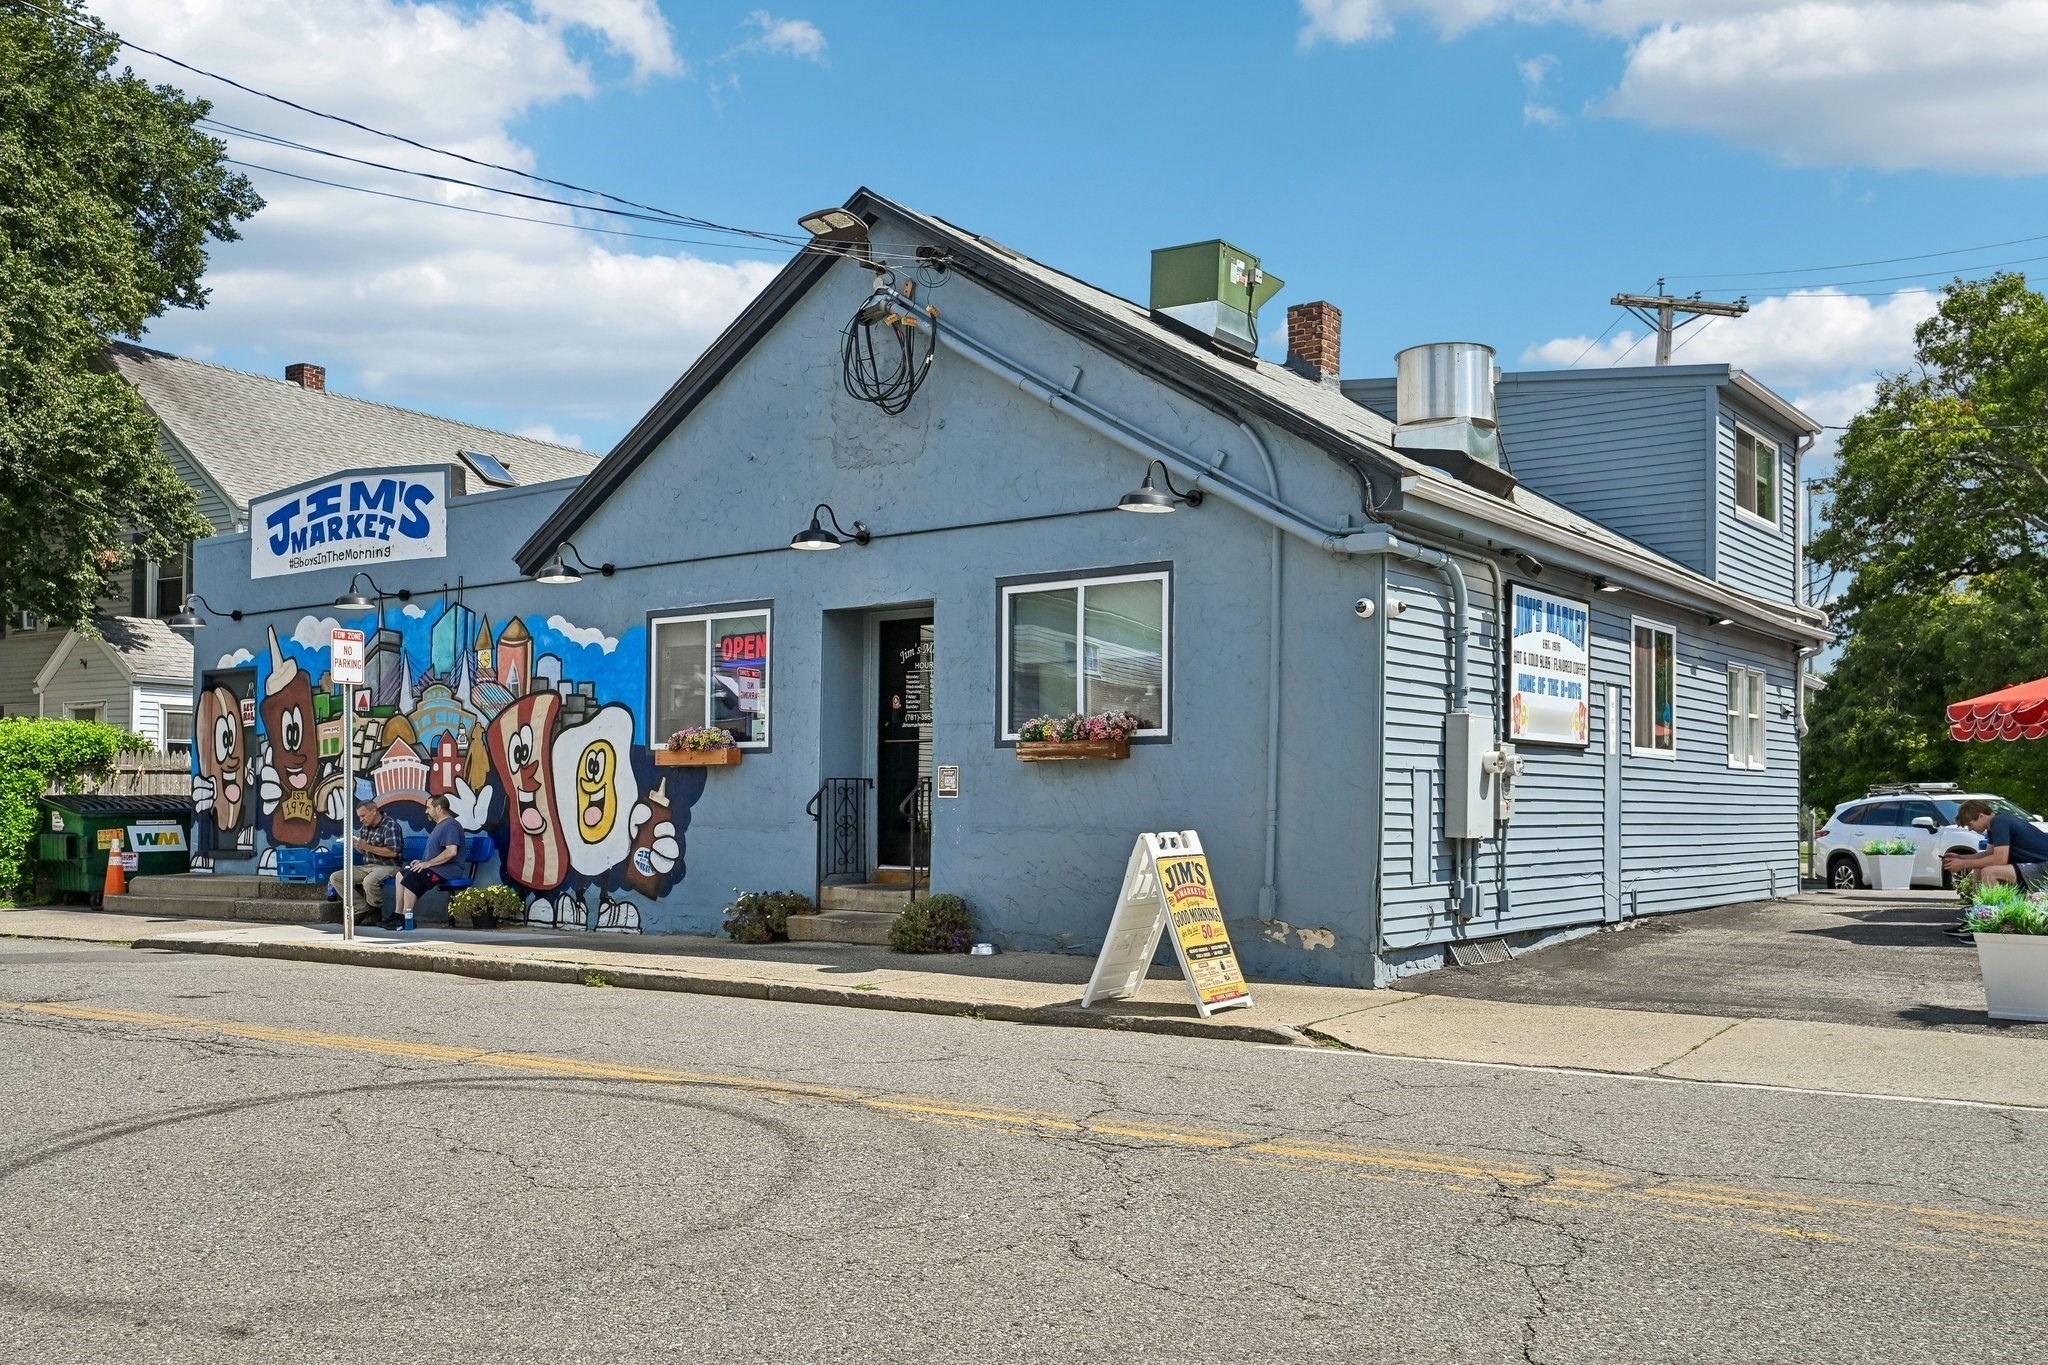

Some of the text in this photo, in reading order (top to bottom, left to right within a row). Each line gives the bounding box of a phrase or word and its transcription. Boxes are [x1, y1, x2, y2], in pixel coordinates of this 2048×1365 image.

[267, 479, 435, 557] JIM'S
[291, 513, 396, 554] MARKET
[1514, 594, 1586, 652] JIM'S MARKET
[334, 631, 362, 640] TOW ZONE
[343, 645, 353, 656] NO
[722, 634, 767, 661] OPEN
[900, 643, 921, 664] Jim's
[334, 657, 362, 670] PARKING
[914, 662, 934, 670] HOUR
[1518, 673, 1536, 693] HOME
[1548, 678, 1559, 697] THE
[292, 792, 305, 800] EST
[286, 802, 312, 817] 1976
[136, 832, 180, 846] WM
[1165, 861, 1206, 892] JIM'S
[1180, 887, 1202, 898] MARKET
[1173, 907, 1221, 928] GOOD MORNINGS
[1201, 924, 1212, 939] 50
